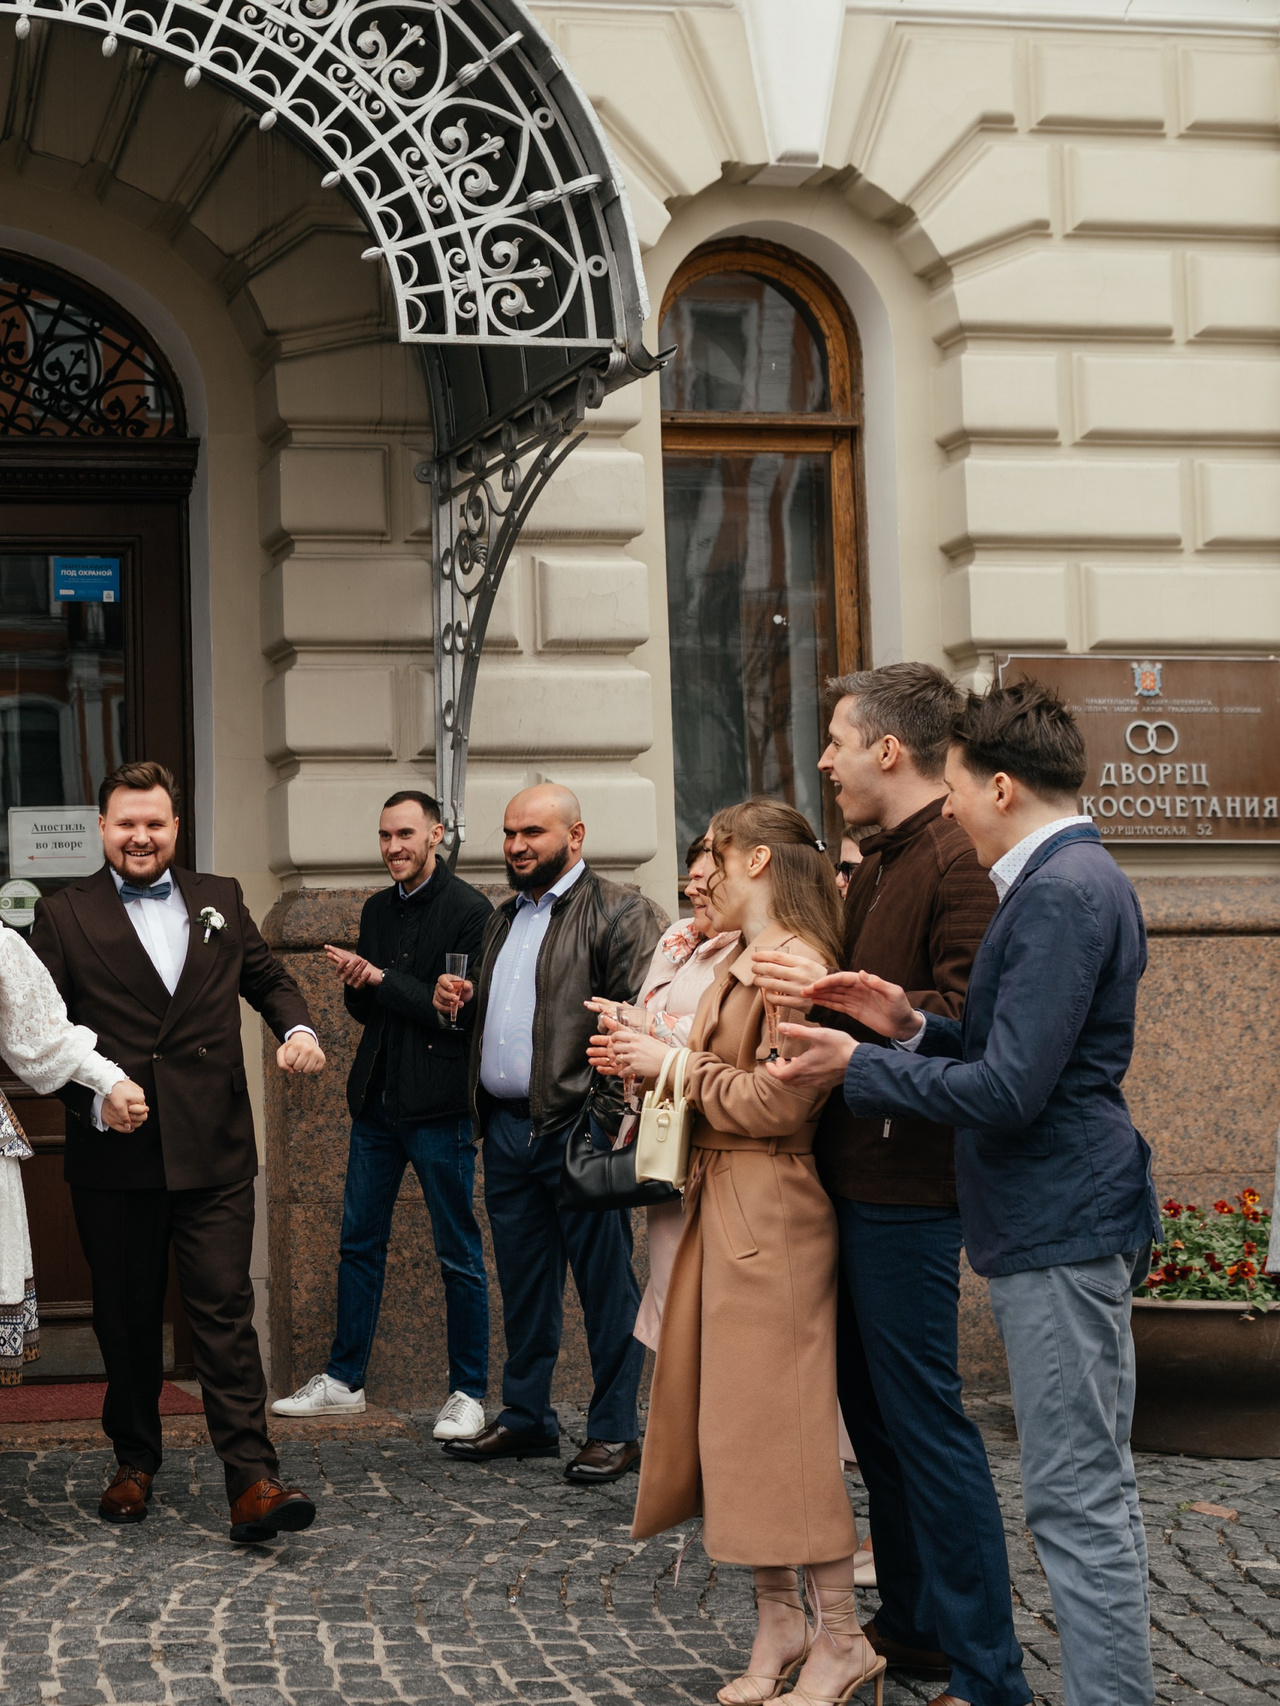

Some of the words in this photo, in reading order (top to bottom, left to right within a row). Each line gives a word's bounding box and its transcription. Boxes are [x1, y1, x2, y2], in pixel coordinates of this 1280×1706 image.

[1085, 698, 1139, 706] ПРАВИТЕЛЬСТВО
[1100, 763, 1210, 787] ДВОРЕЦ
[1081, 795, 1279, 819] КОСОЧЕТАНИЯ
[31, 823, 86, 833] Апостиль
[1196, 824, 1213, 836] 52
[51, 841, 83, 851] дворе
